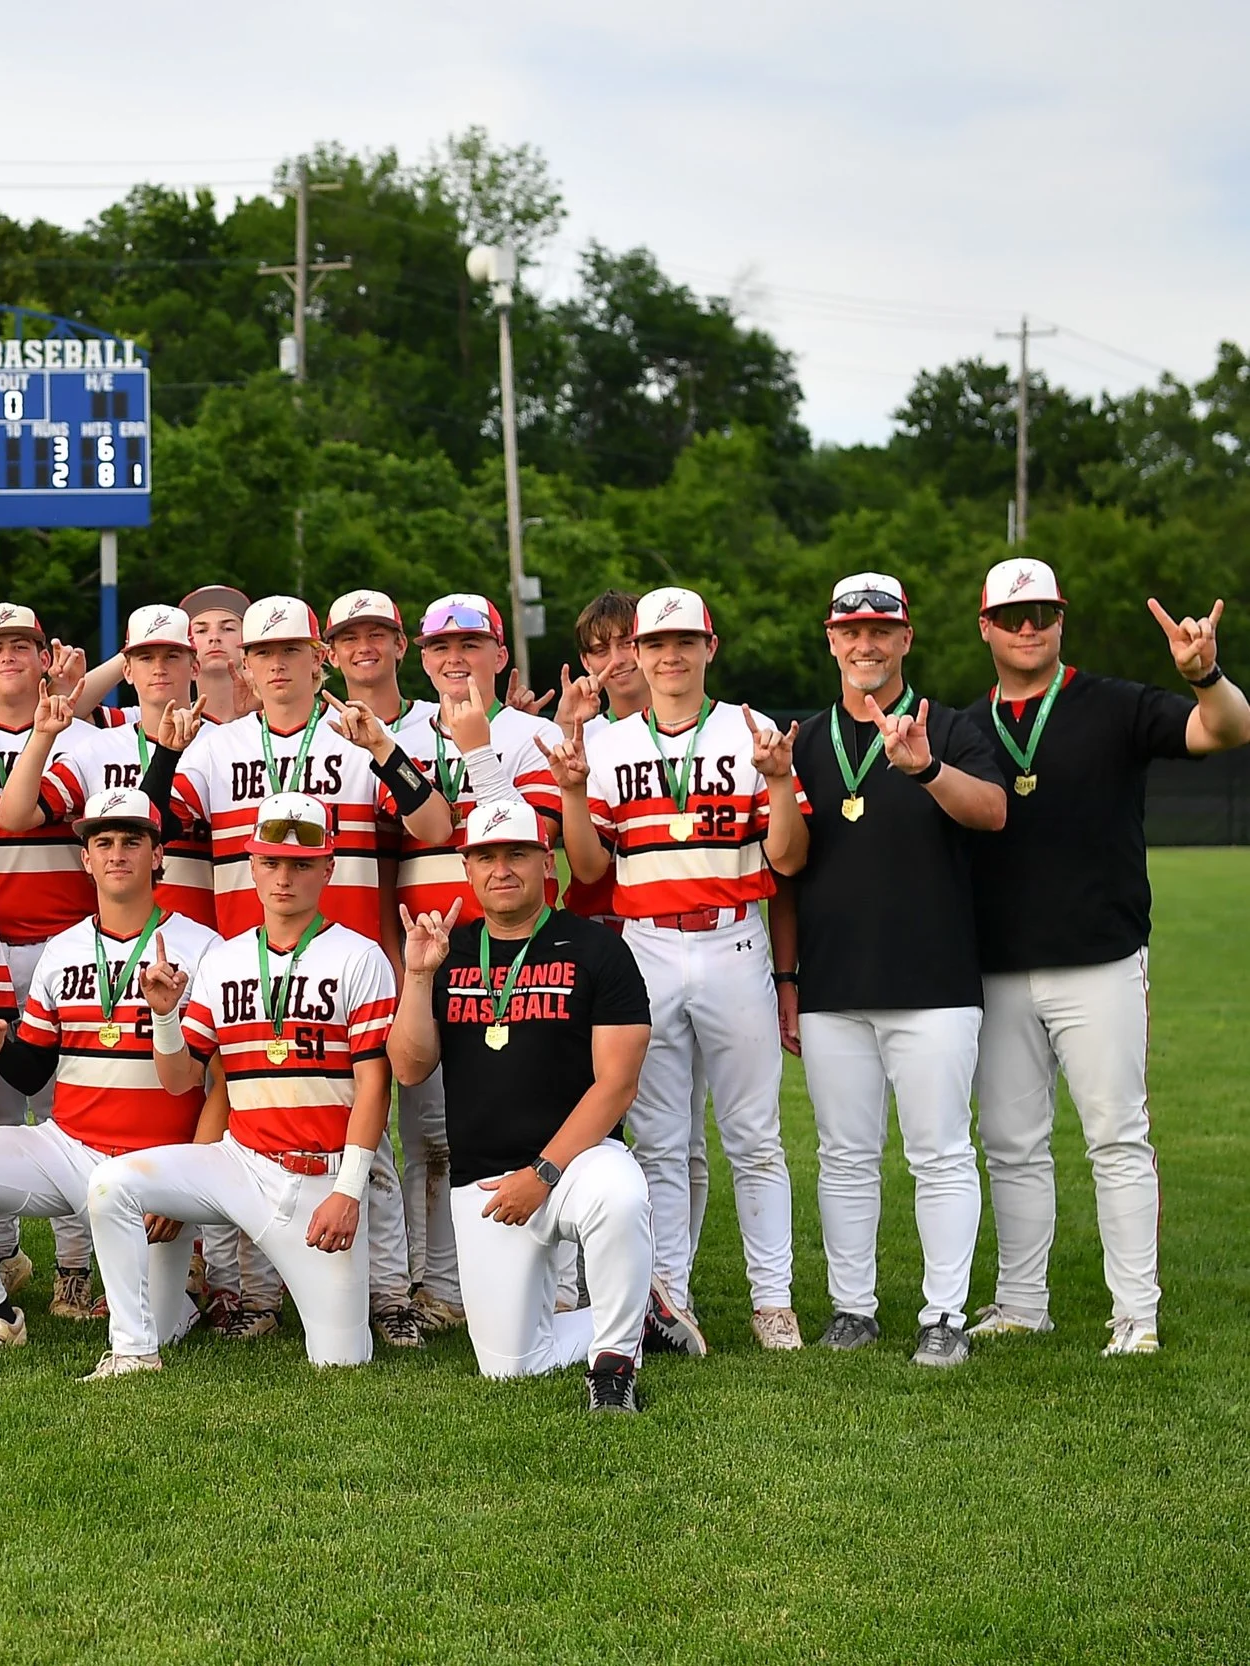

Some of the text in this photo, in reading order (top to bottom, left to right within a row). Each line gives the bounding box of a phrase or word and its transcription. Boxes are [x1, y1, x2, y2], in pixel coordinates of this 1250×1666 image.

[85, 373, 114, 392] H/E
[4, 390, 23, 420] 0
[6, 423, 22, 437] 10
[32, 422, 70, 438] RUNS
[80, 422, 113, 437] HITS
[53, 436, 69, 462] 3
[98, 436, 115, 462] 6
[52, 463, 69, 488] 2
[98, 462, 115, 488] 8
[133, 463, 142, 486] 1
[231, 754, 342, 801] DEVLS
[614, 755, 736, 806] DEVLS
[696, 804, 737, 837] 32
[449, 961, 575, 989] TIPEANOE
[221, 974, 338, 1024] DEVILS
[447, 993, 570, 1024] BASBALL
[295, 1026, 326, 1060] 51
